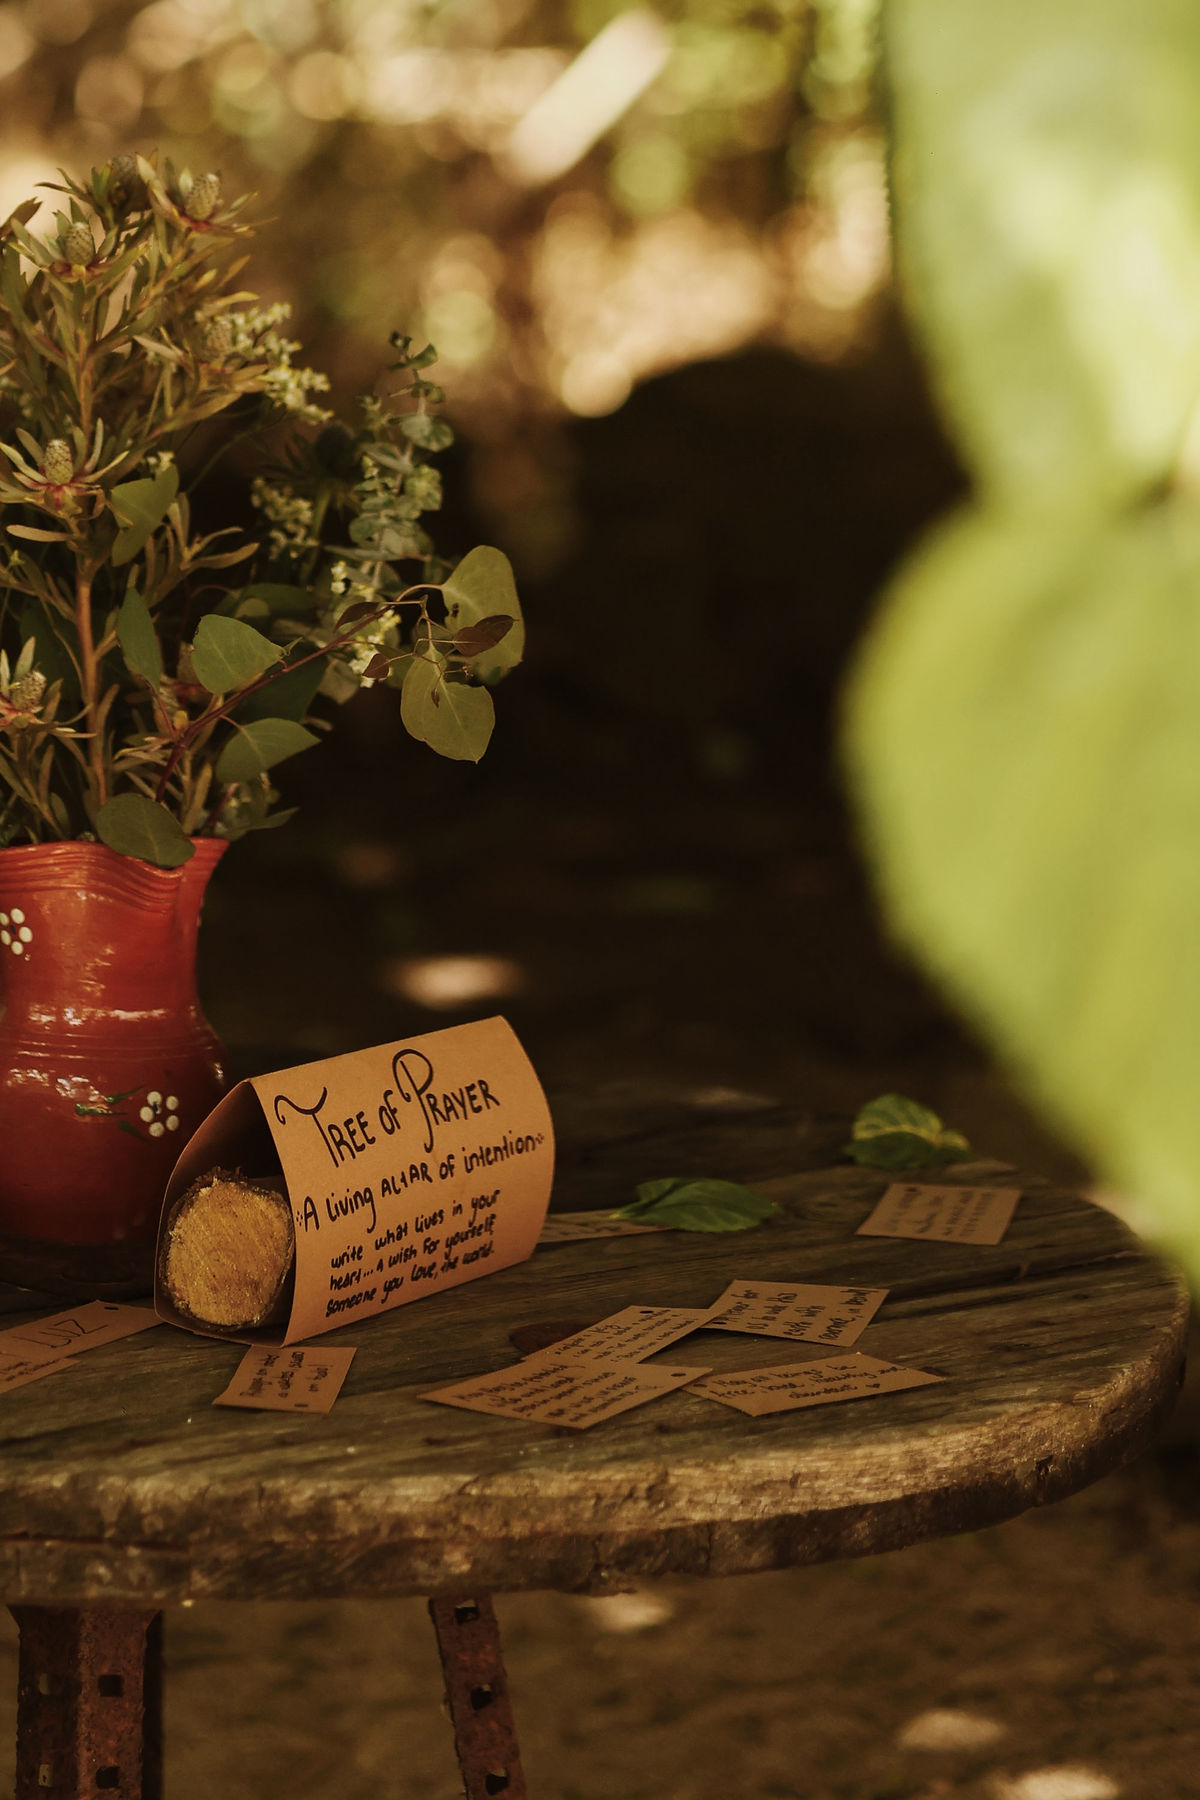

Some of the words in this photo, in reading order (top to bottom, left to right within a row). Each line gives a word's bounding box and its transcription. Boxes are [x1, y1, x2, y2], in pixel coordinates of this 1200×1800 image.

[392, 1049, 501, 1153] PRAYER
[303, 1196, 320, 1232] A
[326, 1187, 377, 1233] living
[461, 1130, 536, 1173] intention
[331, 1245, 363, 1269] write
[375, 1222, 408, 1251] what
[414, 1208, 445, 1233] lives
[452, 1199, 463, 1217] in
[468, 1189, 501, 1227] your
[388, 1244, 417, 1268] wish
[381, 1276, 404, 1304] you
[440, 1255, 459, 1273] the
[11, 1318, 110, 1349] LUZ
